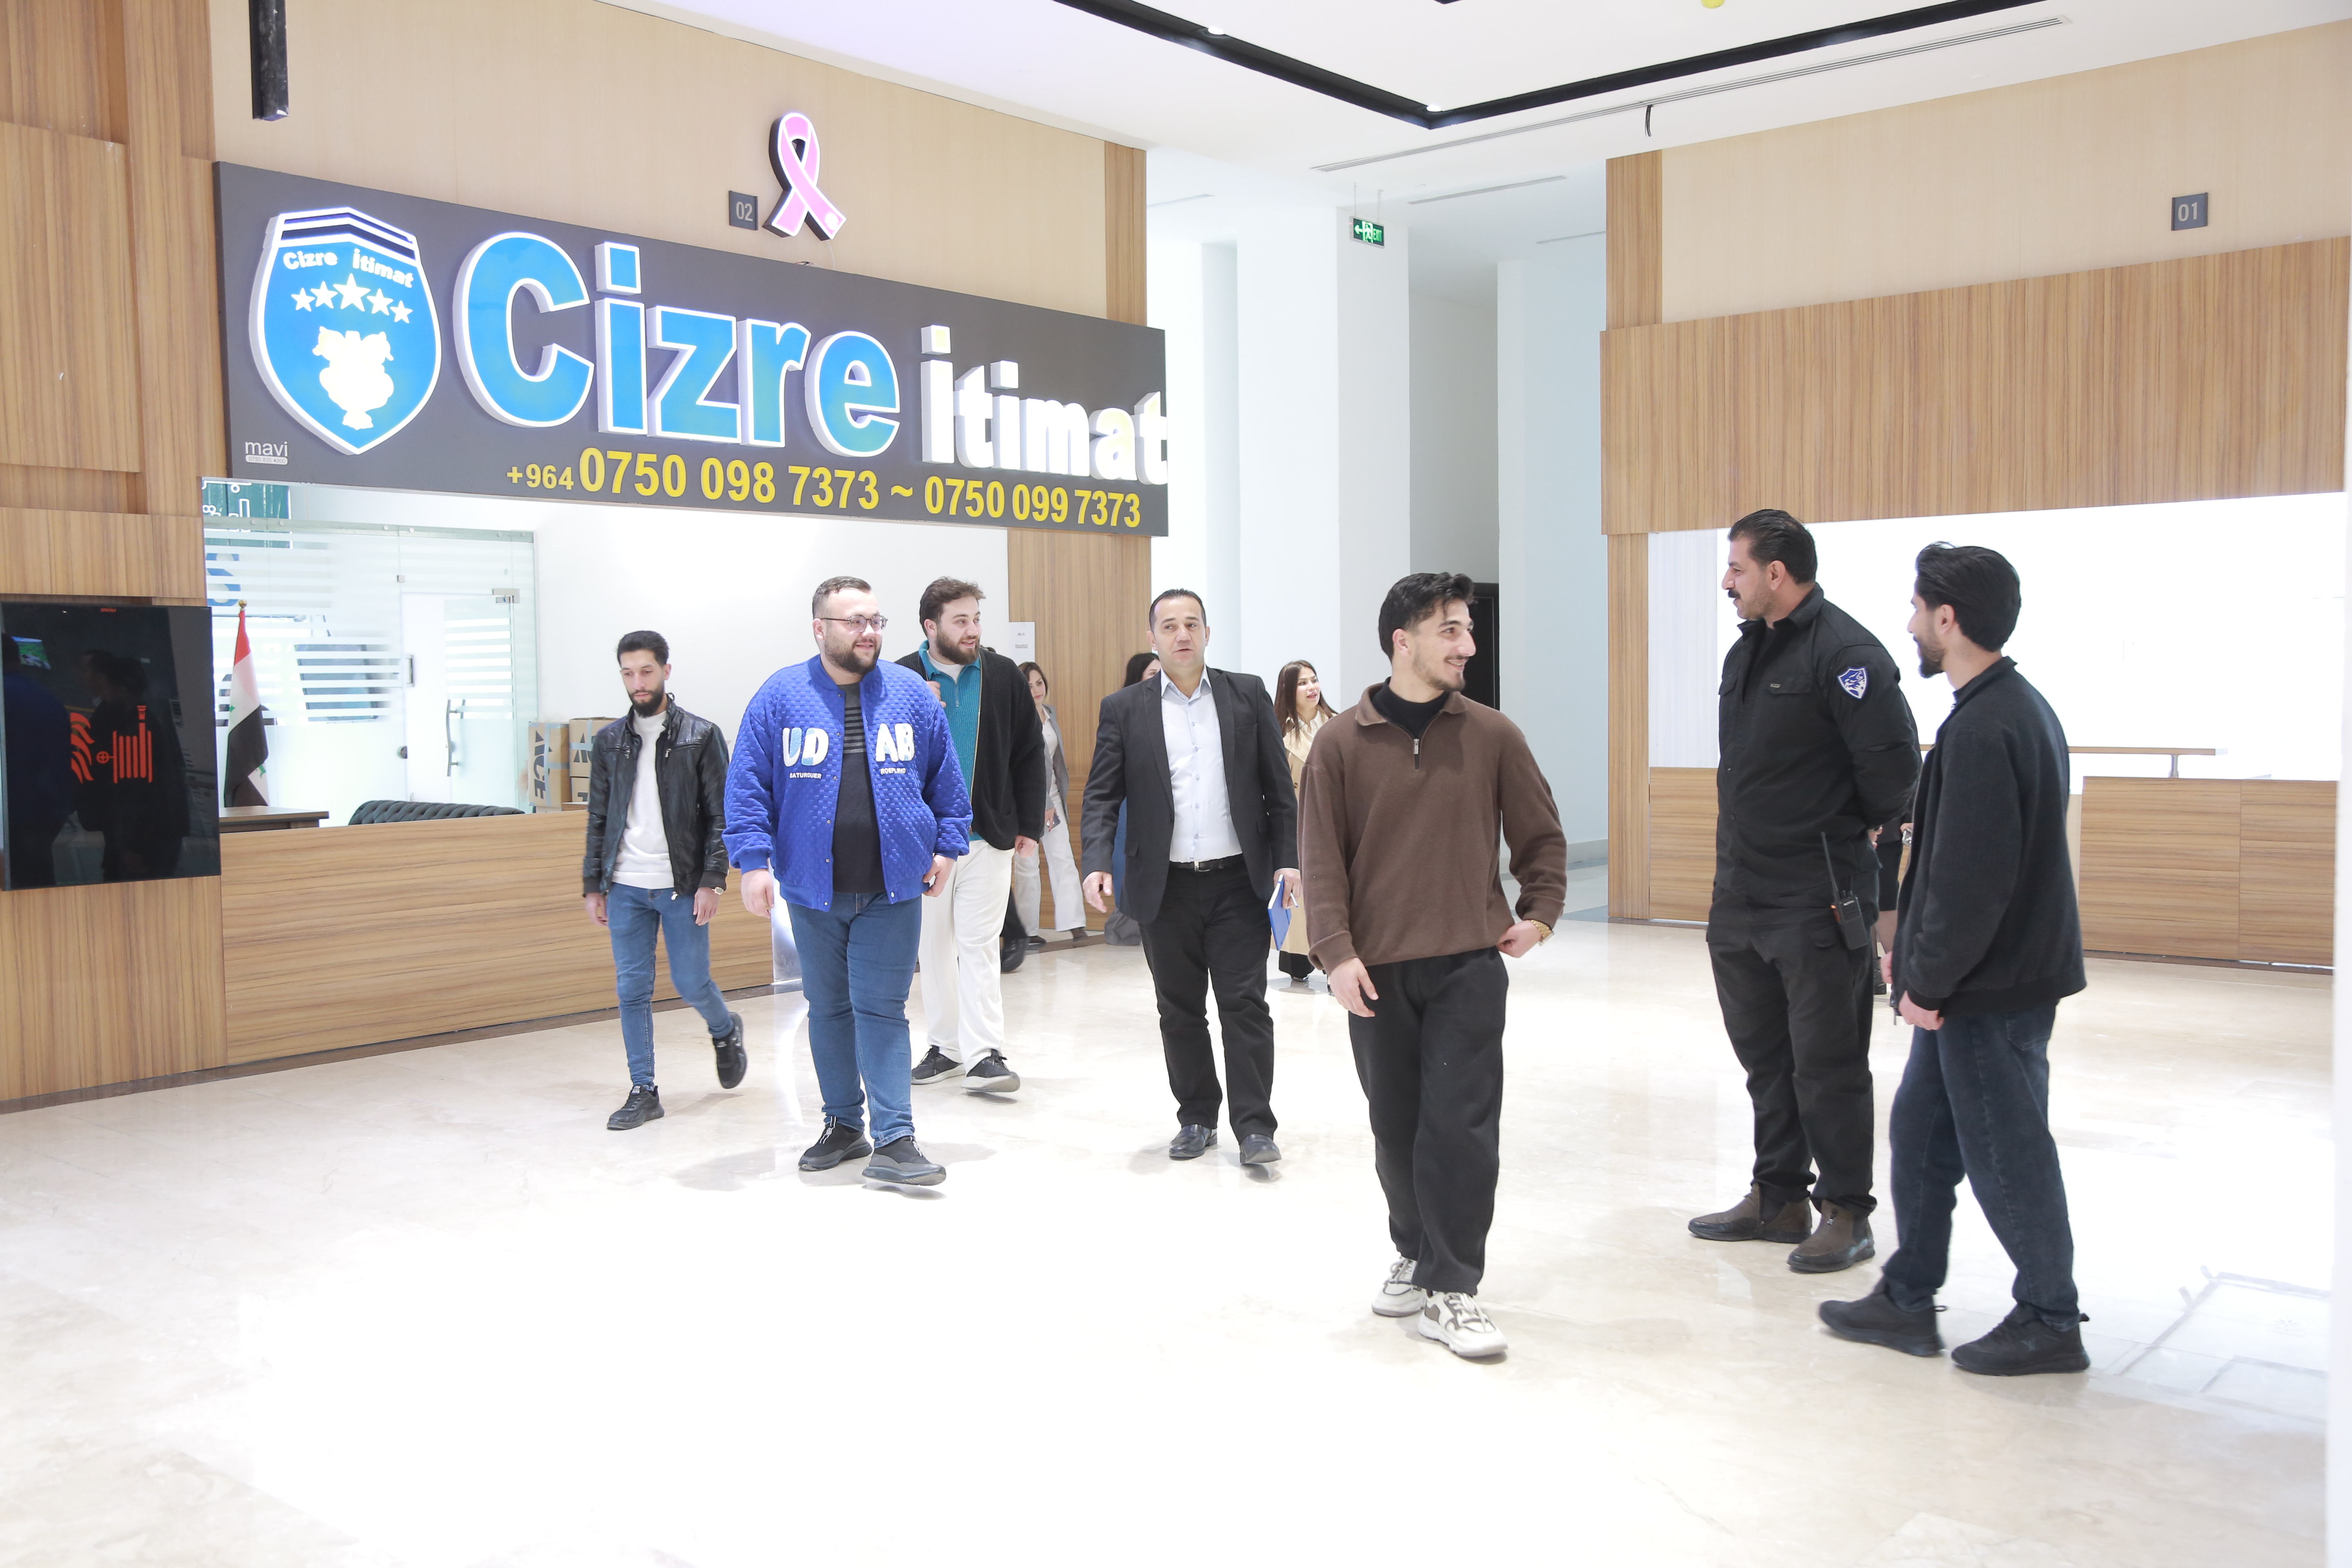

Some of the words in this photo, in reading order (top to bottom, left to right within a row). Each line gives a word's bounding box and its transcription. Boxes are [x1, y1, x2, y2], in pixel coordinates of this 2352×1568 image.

[736, 201, 753, 223] 02
[2178, 202, 2198, 222] 01
[1373, 228, 1382, 242] EXIT
[283, 251, 338, 270] Cizre
[452, 232, 900, 458] Cizre
[245, 441, 288, 457] mavi
[506, 464, 574, 490] +964
[579, 448, 686, 497] 0750
[701, 457, 776, 503] 098
[789, 466, 880, 509] 7373
[925, 476, 1005, 519] 0750
[1013, 483, 1069, 522] 099
[1074, 490, 1141, 528] 7373
[875, 723, 915, 762] AB
